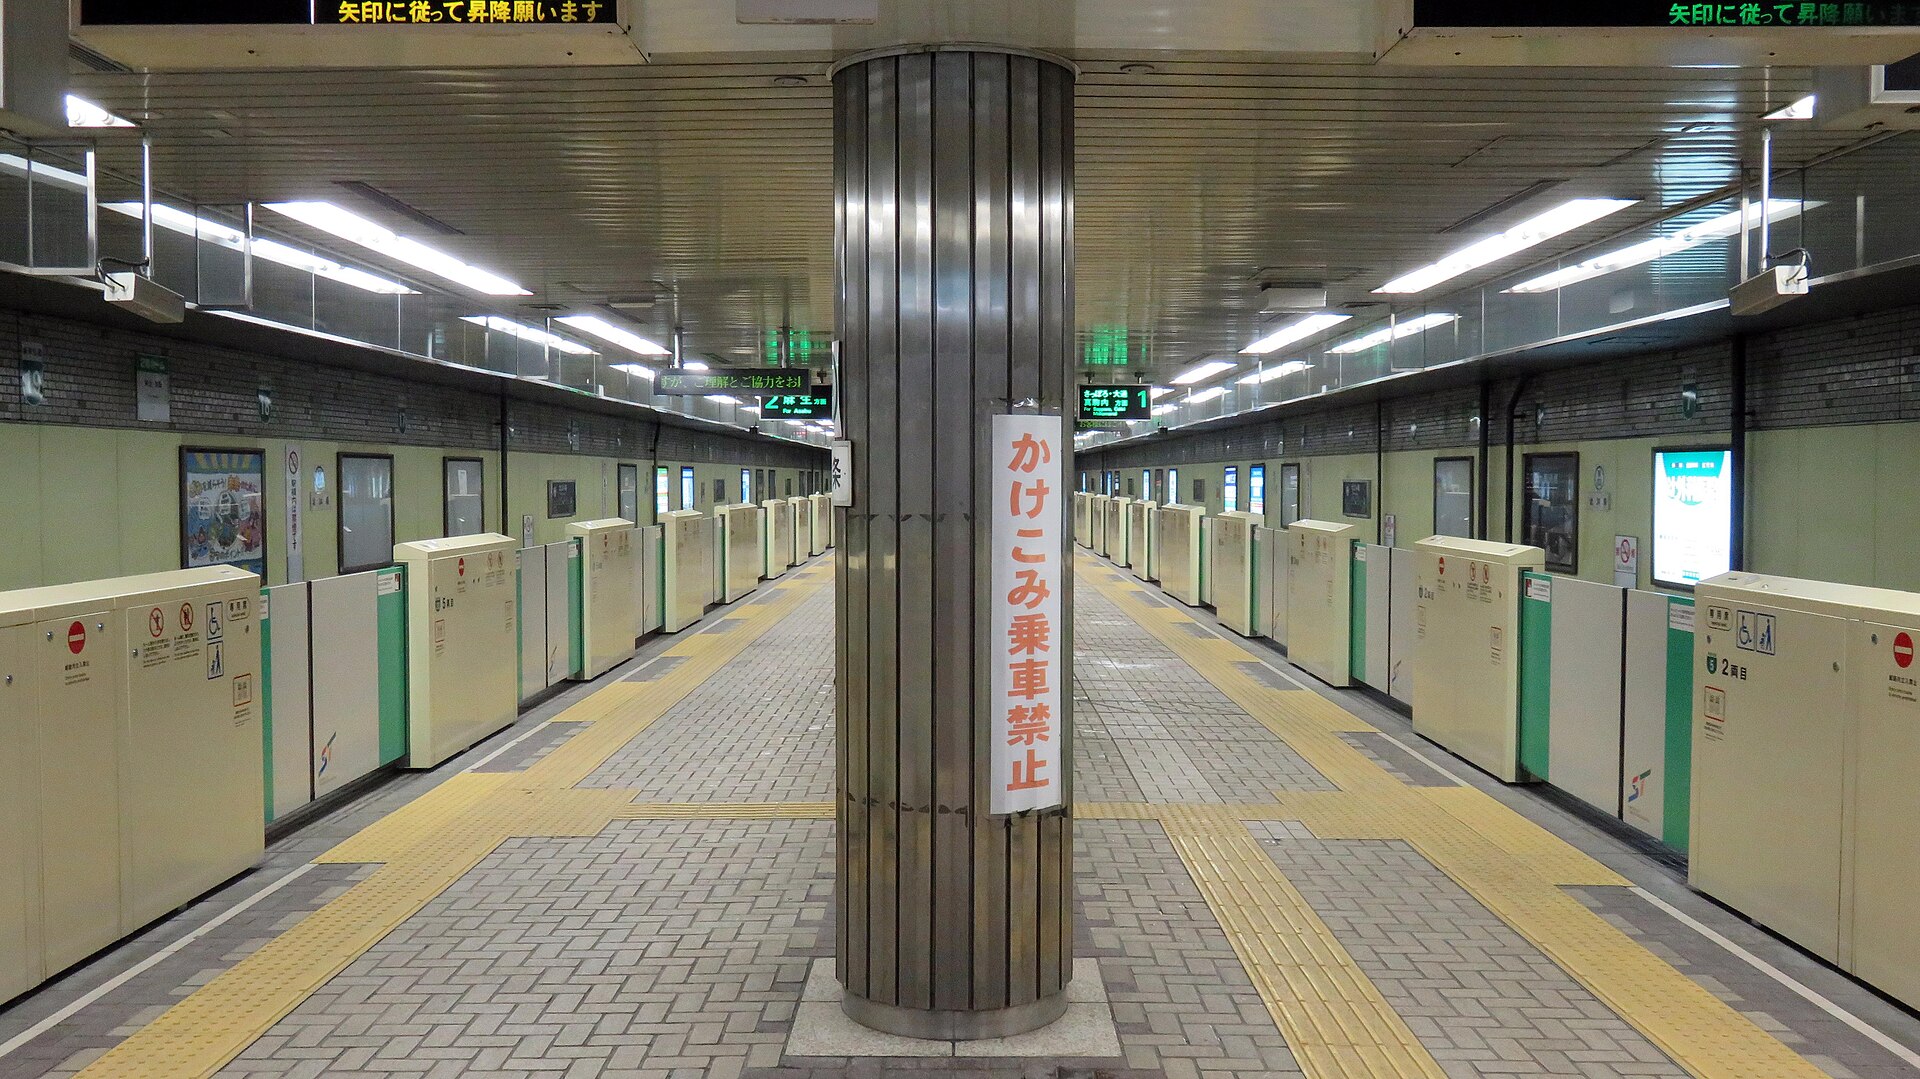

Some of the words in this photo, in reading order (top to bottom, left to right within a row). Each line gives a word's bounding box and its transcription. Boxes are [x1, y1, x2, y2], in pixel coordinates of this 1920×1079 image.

[338, 0, 603, 23] 矢印に従って昇降願います
[661, 375, 801, 389] すが、ご理解とご協力をお
[1137, 390, 1147, 407] 1
[1006, 432, 1051, 792] かけこみ乗車禁止
